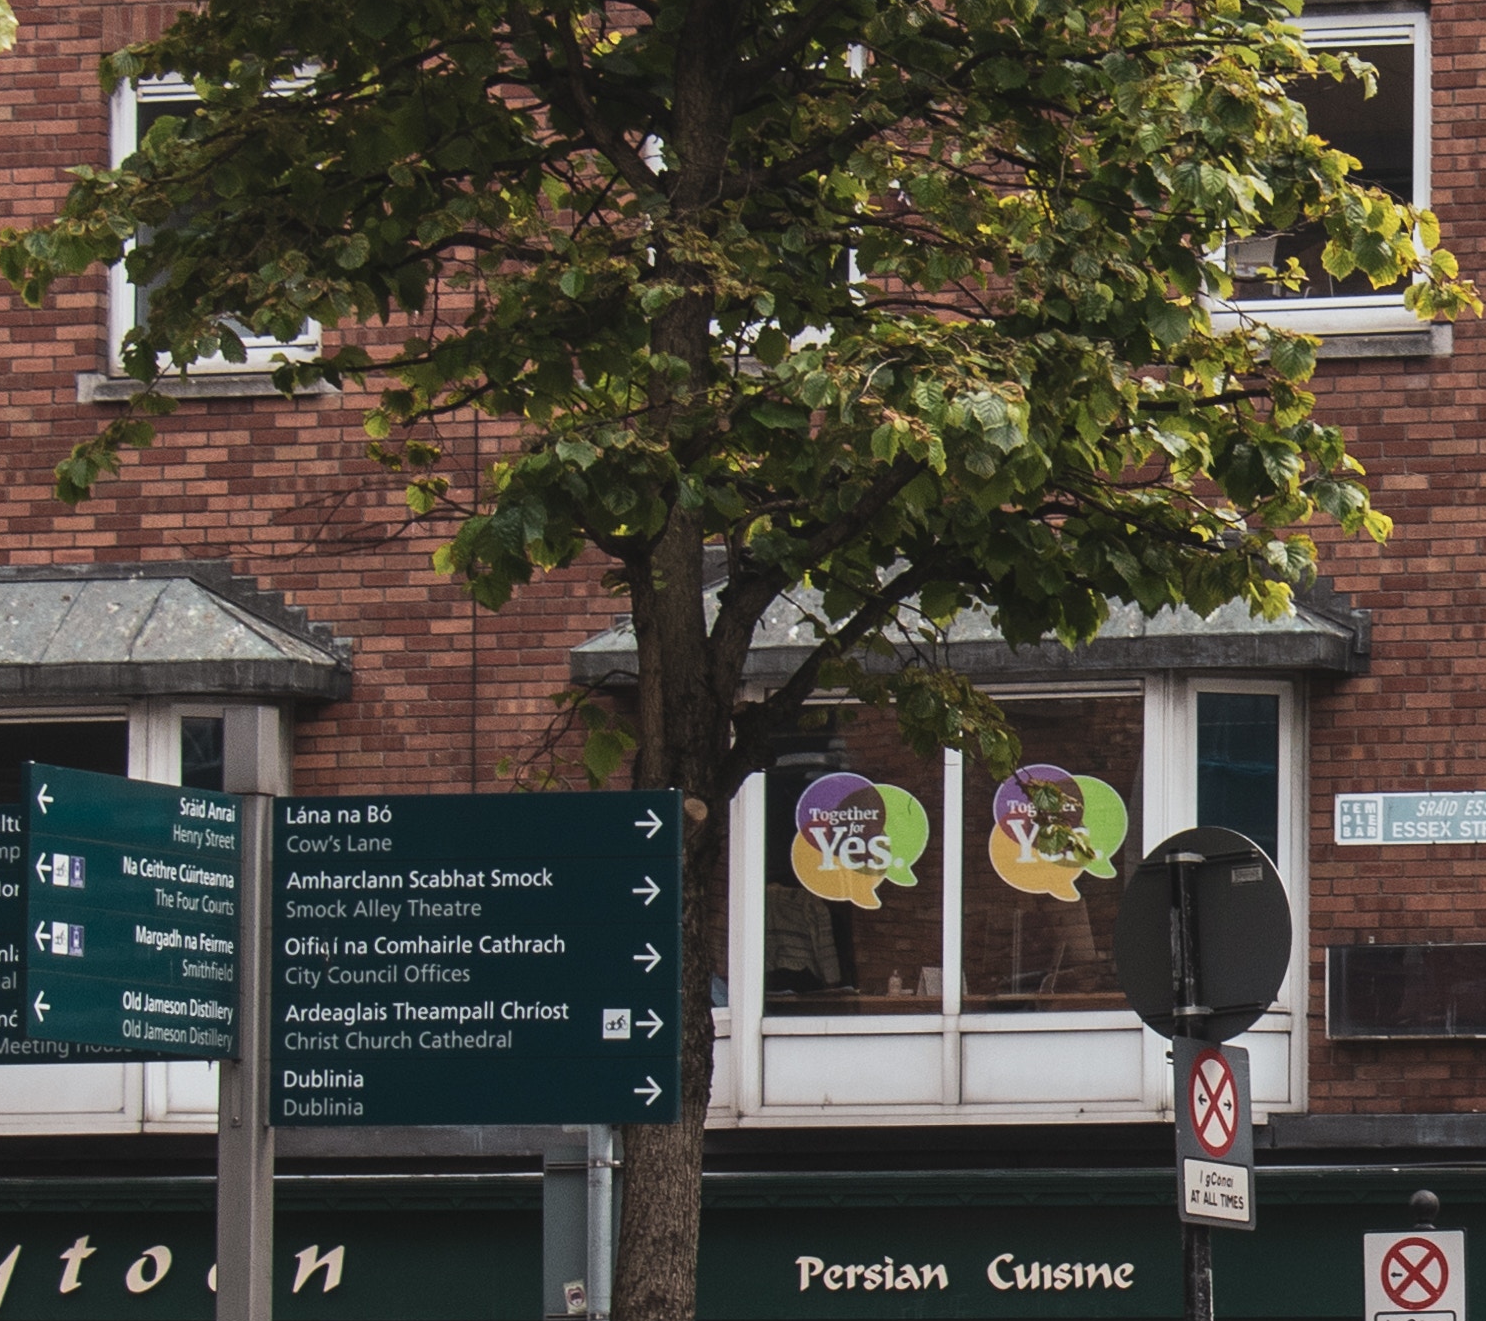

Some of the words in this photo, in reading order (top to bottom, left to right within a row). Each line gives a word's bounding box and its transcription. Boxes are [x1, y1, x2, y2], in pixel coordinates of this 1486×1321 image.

[285, 805, 332, 825] Lána
[336, 808, 362, 824] na
[367, 804, 393, 824] Bó
[808, 806, 880, 825] Together
[1341, 802, 1377, 815] TEM
[1415, 798, 1458, 818] SRÁID
[847, 821, 866, 838] for
[1341, 814, 1377, 826] PLE
[1392, 821, 1452, 839] ESSEX
[172, 823, 203, 850] Henry
[205, 828, 236, 851] Street
[1341, 826, 1377, 838] BAR
[285, 834, 342, 854] Cow's
[346, 834, 393, 853] Lane
[808, 825, 905, 872] Yes.
[122, 855, 139, 876] Na
[139, 857, 178, 882] Ceithre
[285, 870, 404, 890] Amharclann
[408, 868, 486, 889] Scabhat
[490, 866, 554, 888] Smock
[154, 887, 175, 909] The
[176, 890, 200, 912] Four
[201, 894, 234, 917] Courts
[285, 899, 348, 919] Smock
[352, 898, 403, 923] Alley
[406, 897, 483, 918] Theatre
[134, 924, 183, 951] Margadh
[184, 934, 198, 951] na
[199, 932, 235, 955] Feirme
[343, 940, 368, 955] na
[373, 935, 474, 955] Comhairle
[478, 933, 566, 955] Cathrach
[181, 958, 234, 983] Smithfield
[284, 966, 322, 990] City
[327, 964, 398, 985] Council
[403, 963, 472, 984] Offices
[122, 990, 142, 1012] Old
[143, 993, 188, 1016] Jameson
[189, 998, 234, 1026] Distillery
[284, 1001, 388, 1027] Ardeaglais
[393, 999, 495, 1026] Theampall
[500, 999, 571, 1022] Chríost
[121, 1018, 142, 1039] Old
[143, 1021, 188, 1043] Jameson
[189, 1025, 234, 1053] Distillery
[284, 1030, 340, 1051] Christ
[344, 1030, 413, 1050] Church
[417, 1028, 514, 1050] Cathedral
[282, 1069, 365, 1089] Dublinia
[282, 1098, 365, 1117] Dublinia
[1190, 1189, 1200, 1204] AT
[1203, 1191, 1218, 1207] ALL
[1220, 1193, 1244, 1210] TIMES
[794, 1254, 949, 1292] Persian
[986, 1252, 1135, 1292] Cuisine
